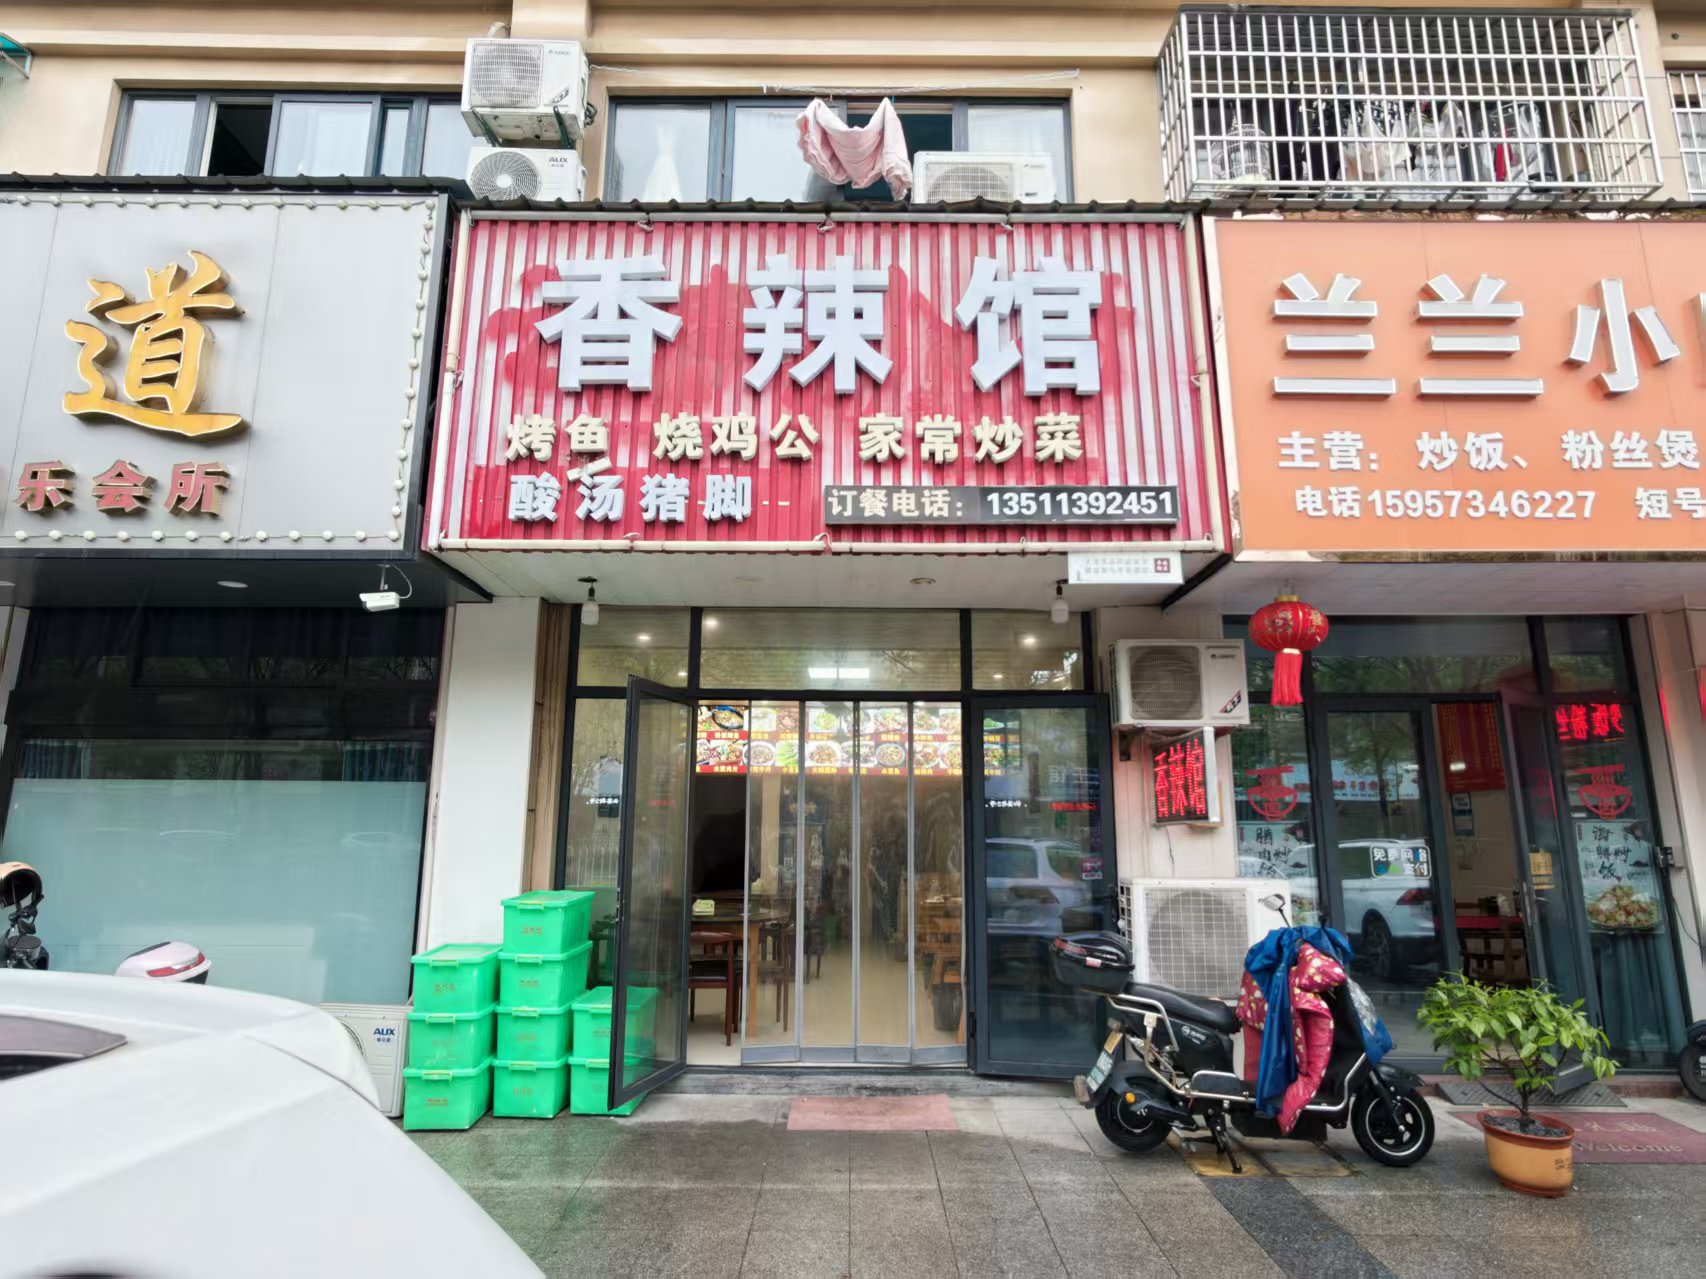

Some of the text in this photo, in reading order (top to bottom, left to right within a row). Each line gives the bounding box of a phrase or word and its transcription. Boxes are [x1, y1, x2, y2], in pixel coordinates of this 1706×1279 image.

[63, 250, 246, 438] 道
[533, 254, 1102, 396] 香辣馆
[1272, 273, 1706, 399] 兰兰小
[505, 411, 1084, 464] 烤鱼 烧鸡公 家常炒菜
[1561, 429, 1700, 471] 粉丝煲
[17, 460, 231, 516] 乐会所
[508, 470, 752, 523] 酸汤猪脚
[986, 490, 1173, 517] 13511392451
[373, 1027, 396, 1036] AUX
